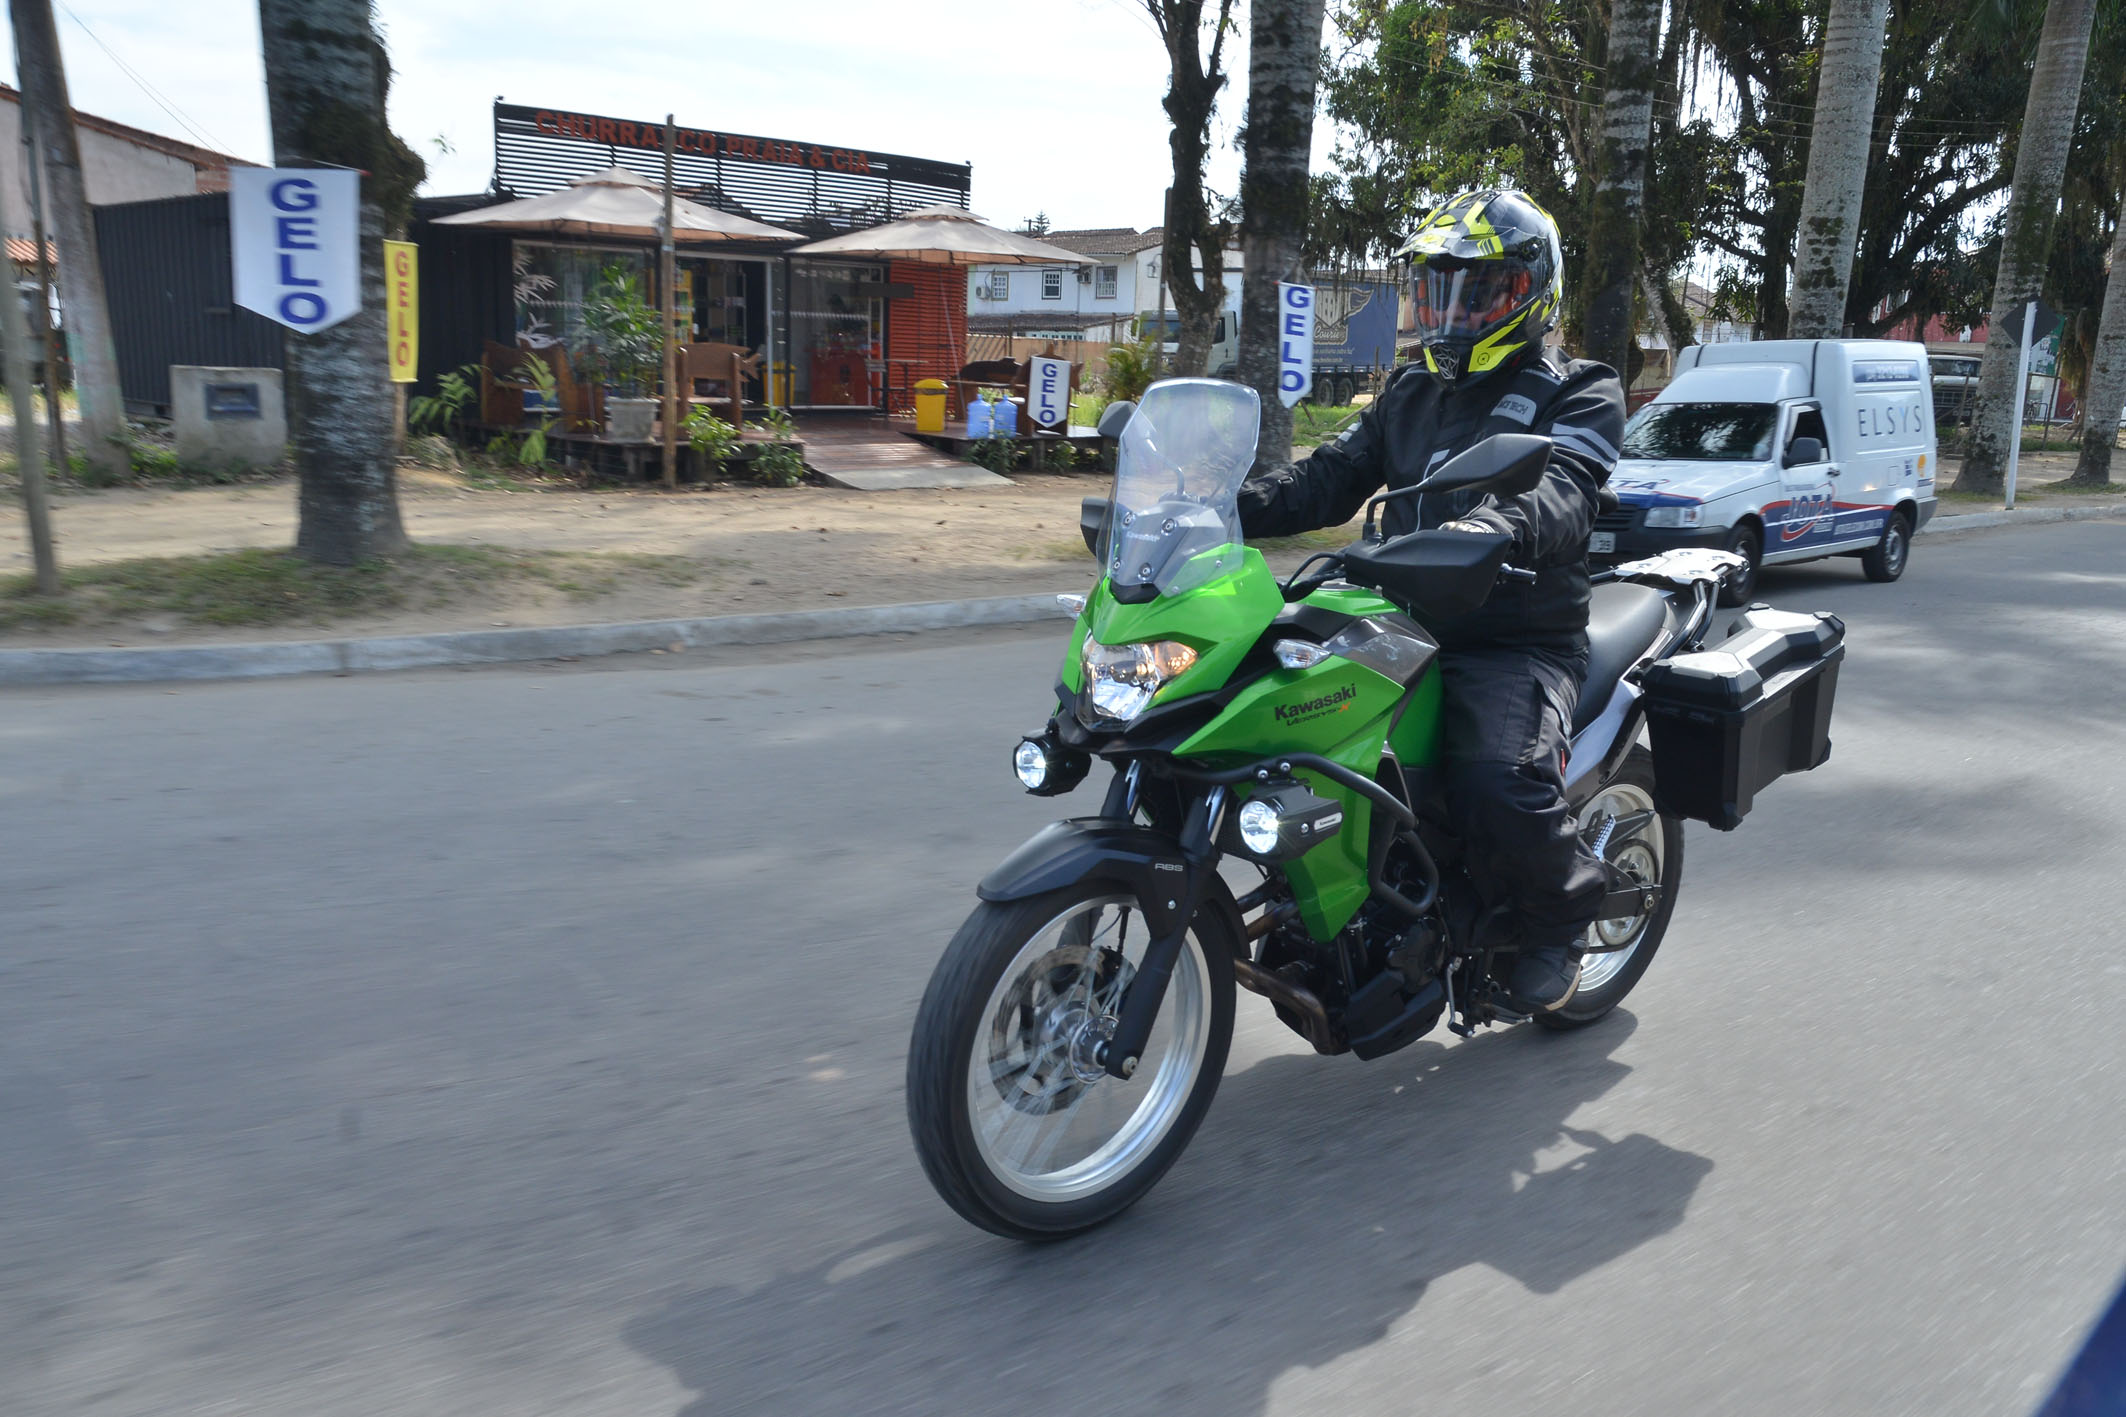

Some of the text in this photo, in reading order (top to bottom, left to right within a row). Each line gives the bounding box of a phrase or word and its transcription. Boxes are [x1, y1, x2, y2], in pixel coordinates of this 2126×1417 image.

[726, 135, 803, 166] PRAIA
[809, 146, 826, 168] &
[832, 148, 871, 174] CIA
[270, 178, 328, 325] GELO
[395, 250, 410, 367] GELO
[1280, 286, 1310, 392] GELO
[1040, 363, 1057, 423] GELO
[1858, 405, 1922, 437] ELSYS
[1274, 683, 1357, 721] Kawasaki
[1154, 862, 1184, 872] ABS
